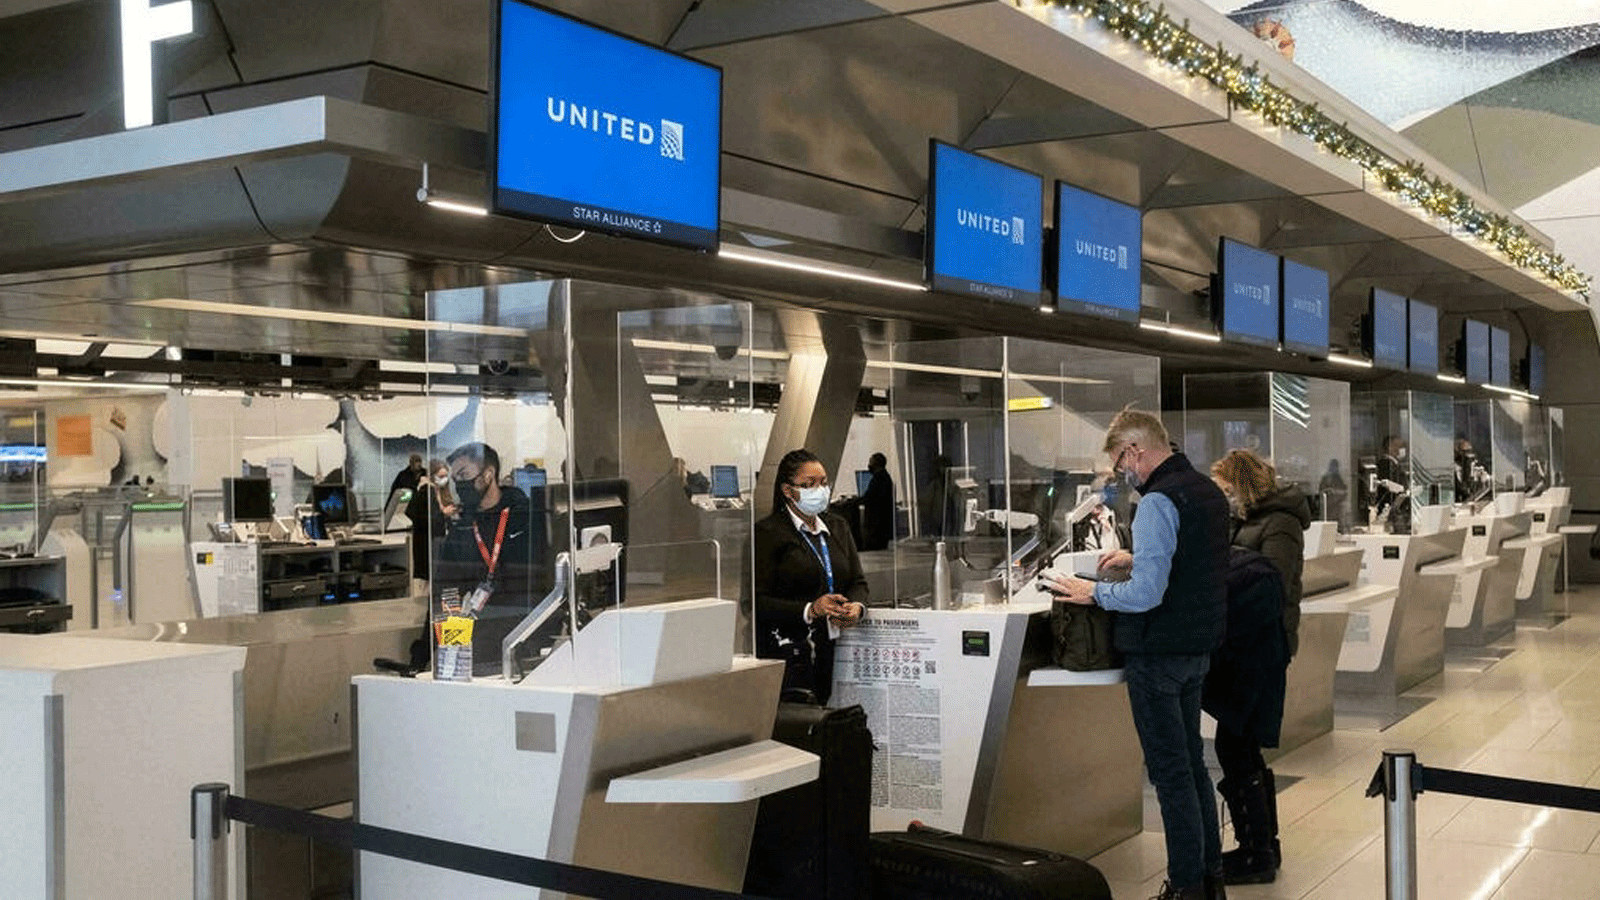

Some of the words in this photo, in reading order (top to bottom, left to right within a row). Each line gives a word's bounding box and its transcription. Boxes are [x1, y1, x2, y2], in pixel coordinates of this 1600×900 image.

[121, 0, 193, 129] F
[547, 97, 654, 145] UNITED
[572, 206, 600, 222] STAR
[602, 211, 651, 233] ALLIANCE
[956, 207, 1010, 237] UNITED
[1075, 240, 1117, 263] UNITED
[883, 619, 919, 627] PASSENGERS
